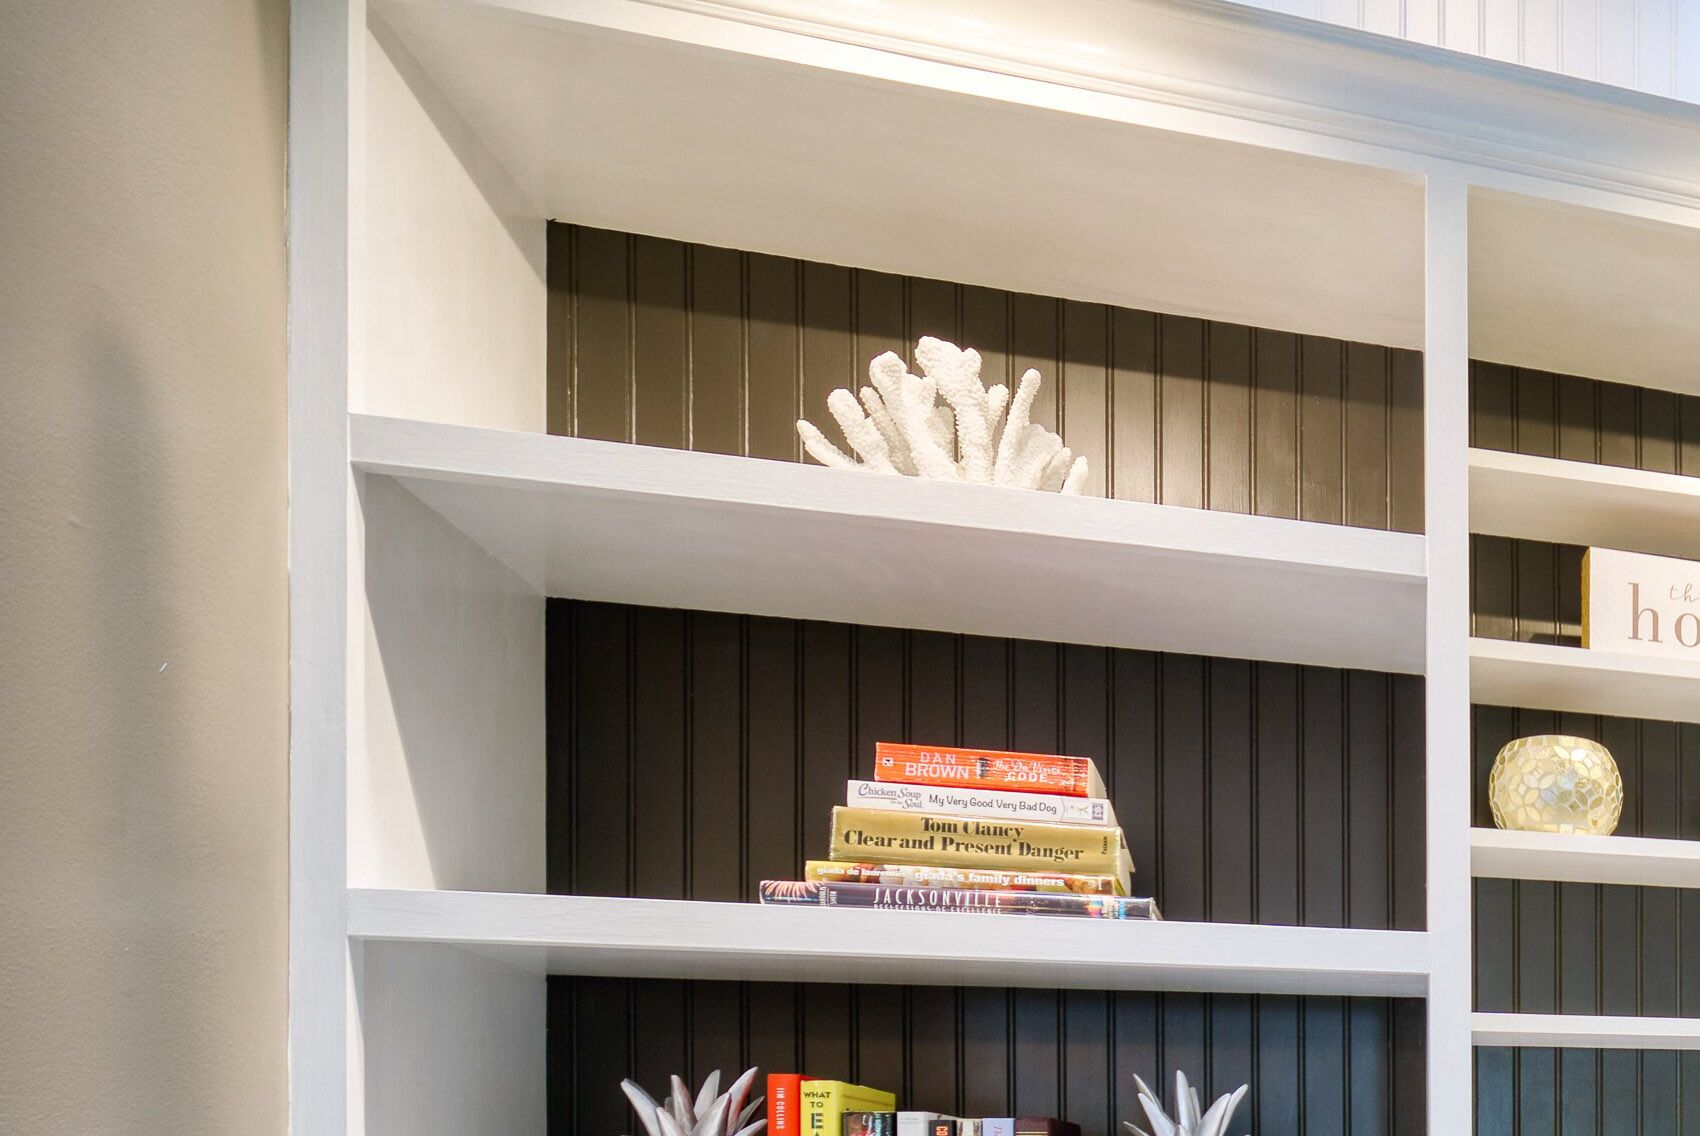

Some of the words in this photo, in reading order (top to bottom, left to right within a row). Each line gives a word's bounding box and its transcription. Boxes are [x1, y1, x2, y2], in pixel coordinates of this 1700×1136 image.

[920, 751, 957, 765] DAN
[904, 763, 969, 780] BROWN
[1004, 770, 1049, 783] CODE
[857, 783, 897, 797] Chicken
[897, 788, 922, 801] Soup
[901, 798, 923, 810] Soul
[928, 794, 945, 807] My
[946, 795, 968, 809] Very
[995, 798, 1018, 813] Very
[1018, 799, 1038, 812] Bad
[1038, 800, 1058, 815] Dog
[920, 816, 958, 833] Tom
[962, 818, 1024, 842] Clancy
[843, 829, 899, 848] Clear
[899, 834, 935, 850] and
[940, 836, 1015, 855] Present
[1018, 840, 1085, 862] Danger
[846, 866, 860, 876] de
[915, 869, 965, 882] giada's
[968, 871, 1015, 887] family
[1014, 875, 1066, 887] dinners
[873, 887, 1001, 908] JACKSONVILLE
[775, 1087, 785, 1099] JIM
[803, 1091, 832, 1099] WHAT
[775, 1101, 785, 1130] COLLINS
